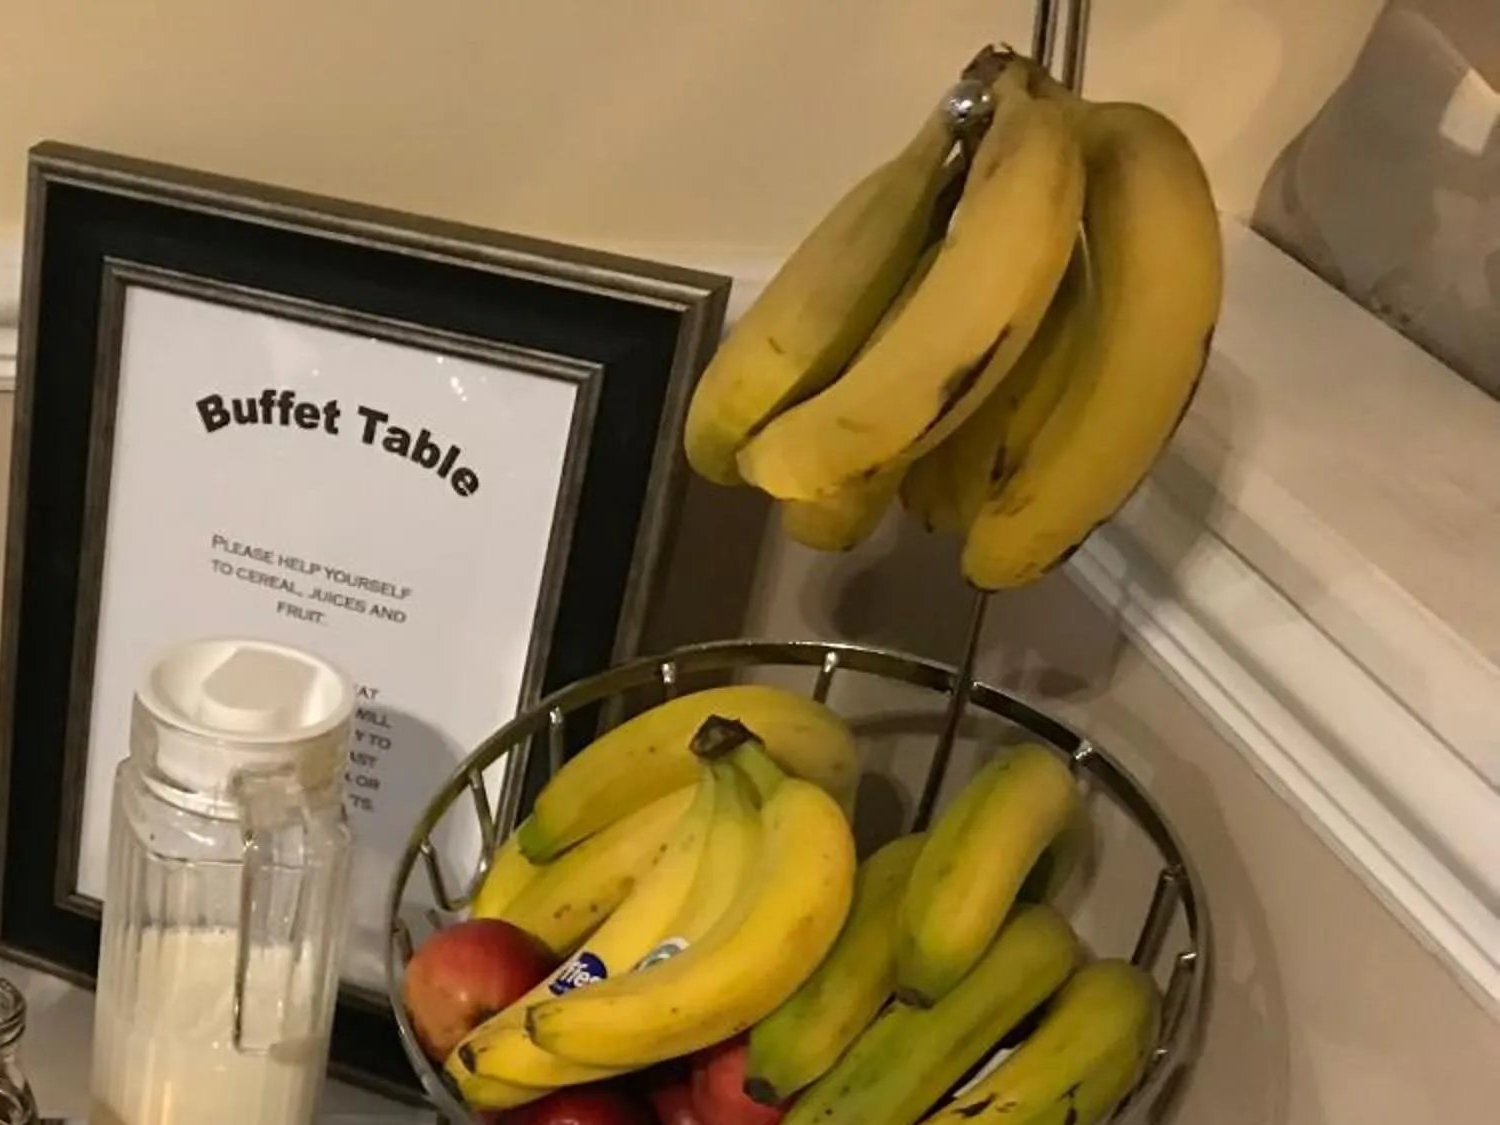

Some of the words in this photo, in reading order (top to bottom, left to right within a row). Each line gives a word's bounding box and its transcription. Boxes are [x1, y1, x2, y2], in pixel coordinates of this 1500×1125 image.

[196, 389, 341, 435] Buffet
[357, 405, 480, 497] Table
[211, 534, 275, 565] PLEASE
[278, 553, 321, 575] HELP
[324, 566, 412, 600] YOURSELF
[211, 558, 234, 576] TO
[307, 587, 367, 614] JUICES
[369, 604, 407, 625] AND
